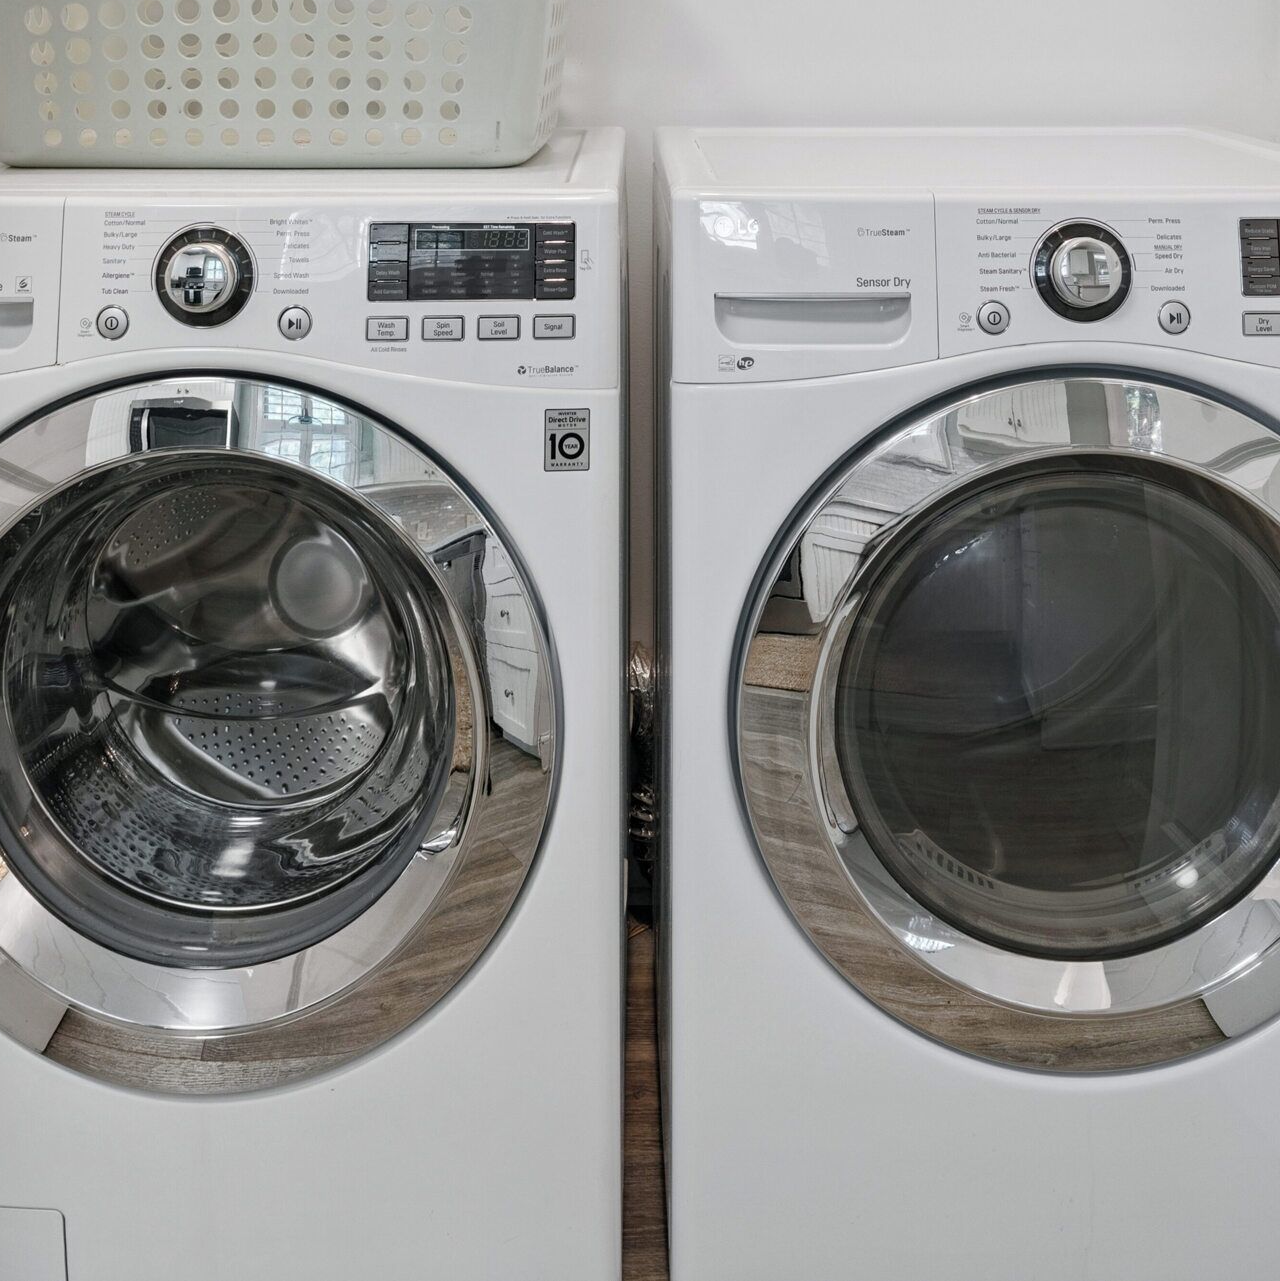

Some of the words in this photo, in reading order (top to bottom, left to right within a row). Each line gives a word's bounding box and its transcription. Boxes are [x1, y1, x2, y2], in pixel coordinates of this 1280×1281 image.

[865, 227, 906, 237] TrueSteam
[856, 276, 891, 288] Sensor
[893, 276, 912, 289] Dry
[1258, 318, 1270, 326] Dry
[544, 323, 563, 331] Signal
[377, 329, 395, 337] Temp.
[528, 365, 574, 374] TrueBalance
[549, 432, 585, 460] 10
